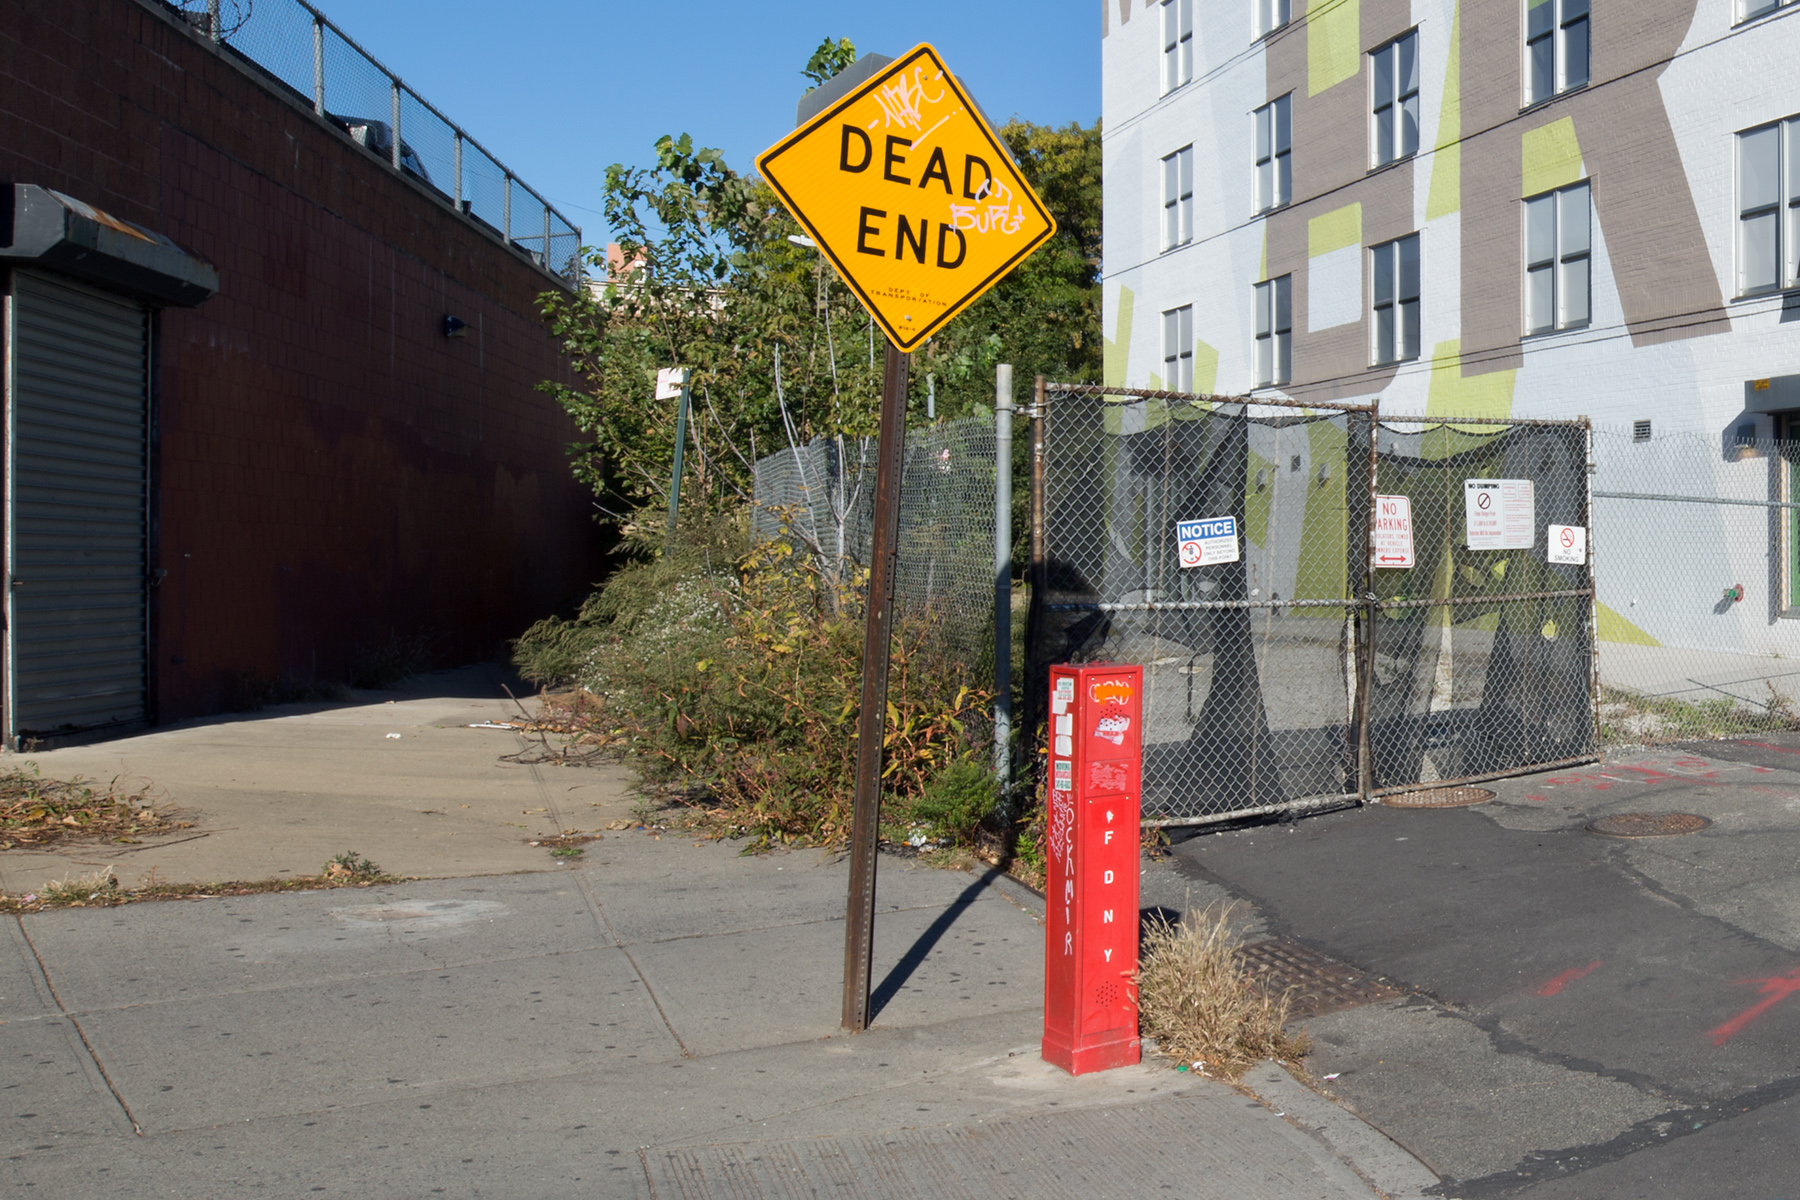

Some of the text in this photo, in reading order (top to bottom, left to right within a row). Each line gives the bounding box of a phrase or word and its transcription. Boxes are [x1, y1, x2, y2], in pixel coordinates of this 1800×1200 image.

[840, 123, 992, 200] DEAD
[857, 206, 966, 270] END
[871, 289, 947, 307] TRANSPORTATION
[889, 287, 910, 295] DEPT
[1382, 503, 1397, 515] NO
[1181, 521, 1233, 539] NOTICE
[1377, 518, 1408, 531] ARKING
[1104, 830, 1114, 962] FDNY
